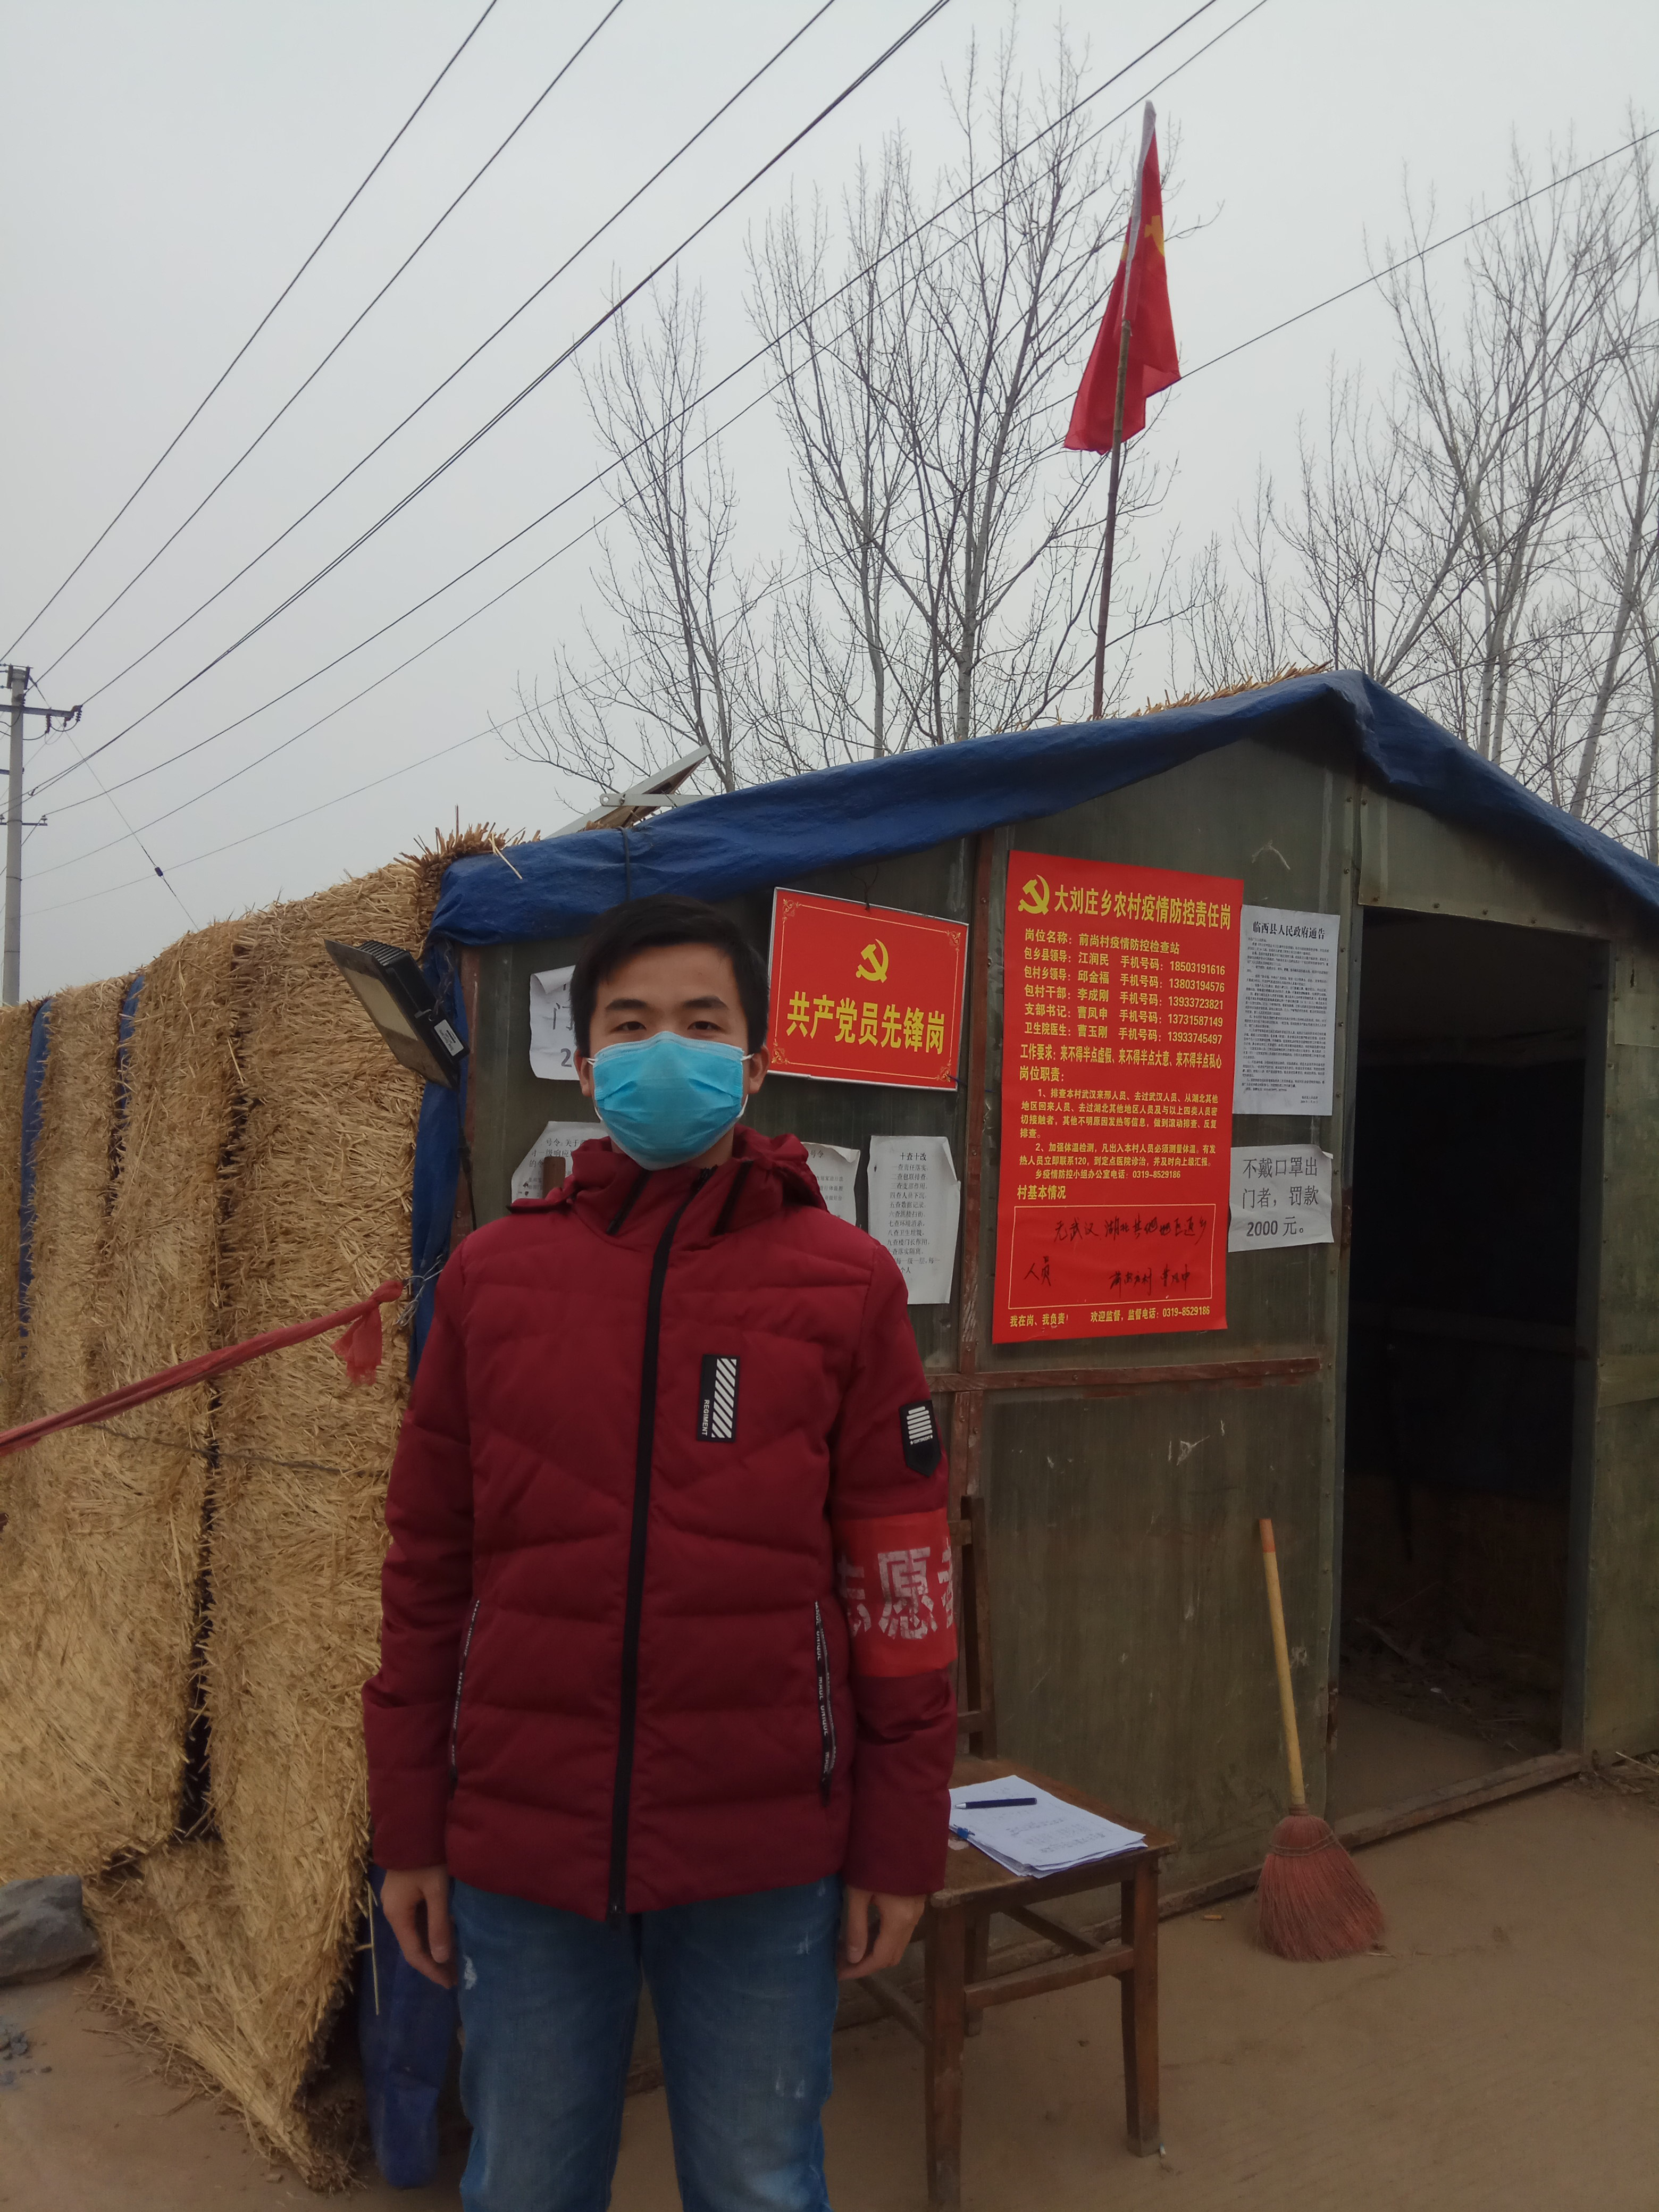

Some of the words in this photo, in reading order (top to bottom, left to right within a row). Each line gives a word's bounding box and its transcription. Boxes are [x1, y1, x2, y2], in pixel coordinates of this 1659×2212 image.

[1054, 884, 1230, 930] 大刘庄乡农村疫情防控责任岗
[1252, 921, 1325, 940] 临西县人民政府通告
[786, 991, 944, 1054] 共产党员先锋岗
[1019, 1065, 1064, 1082] 岗位职责：
[1020, 1128, 1041, 1138] 排查。
[900, 1152, 927, 1161] 十查十改
[1243, 1157, 1317, 1179] 不戴口罩出
[1017, 1185, 1066, 1200] 村基本情况
[1023, 1256, 1051, 1286] 人员
[701, 1400, 710, 1436] REGIMENT
